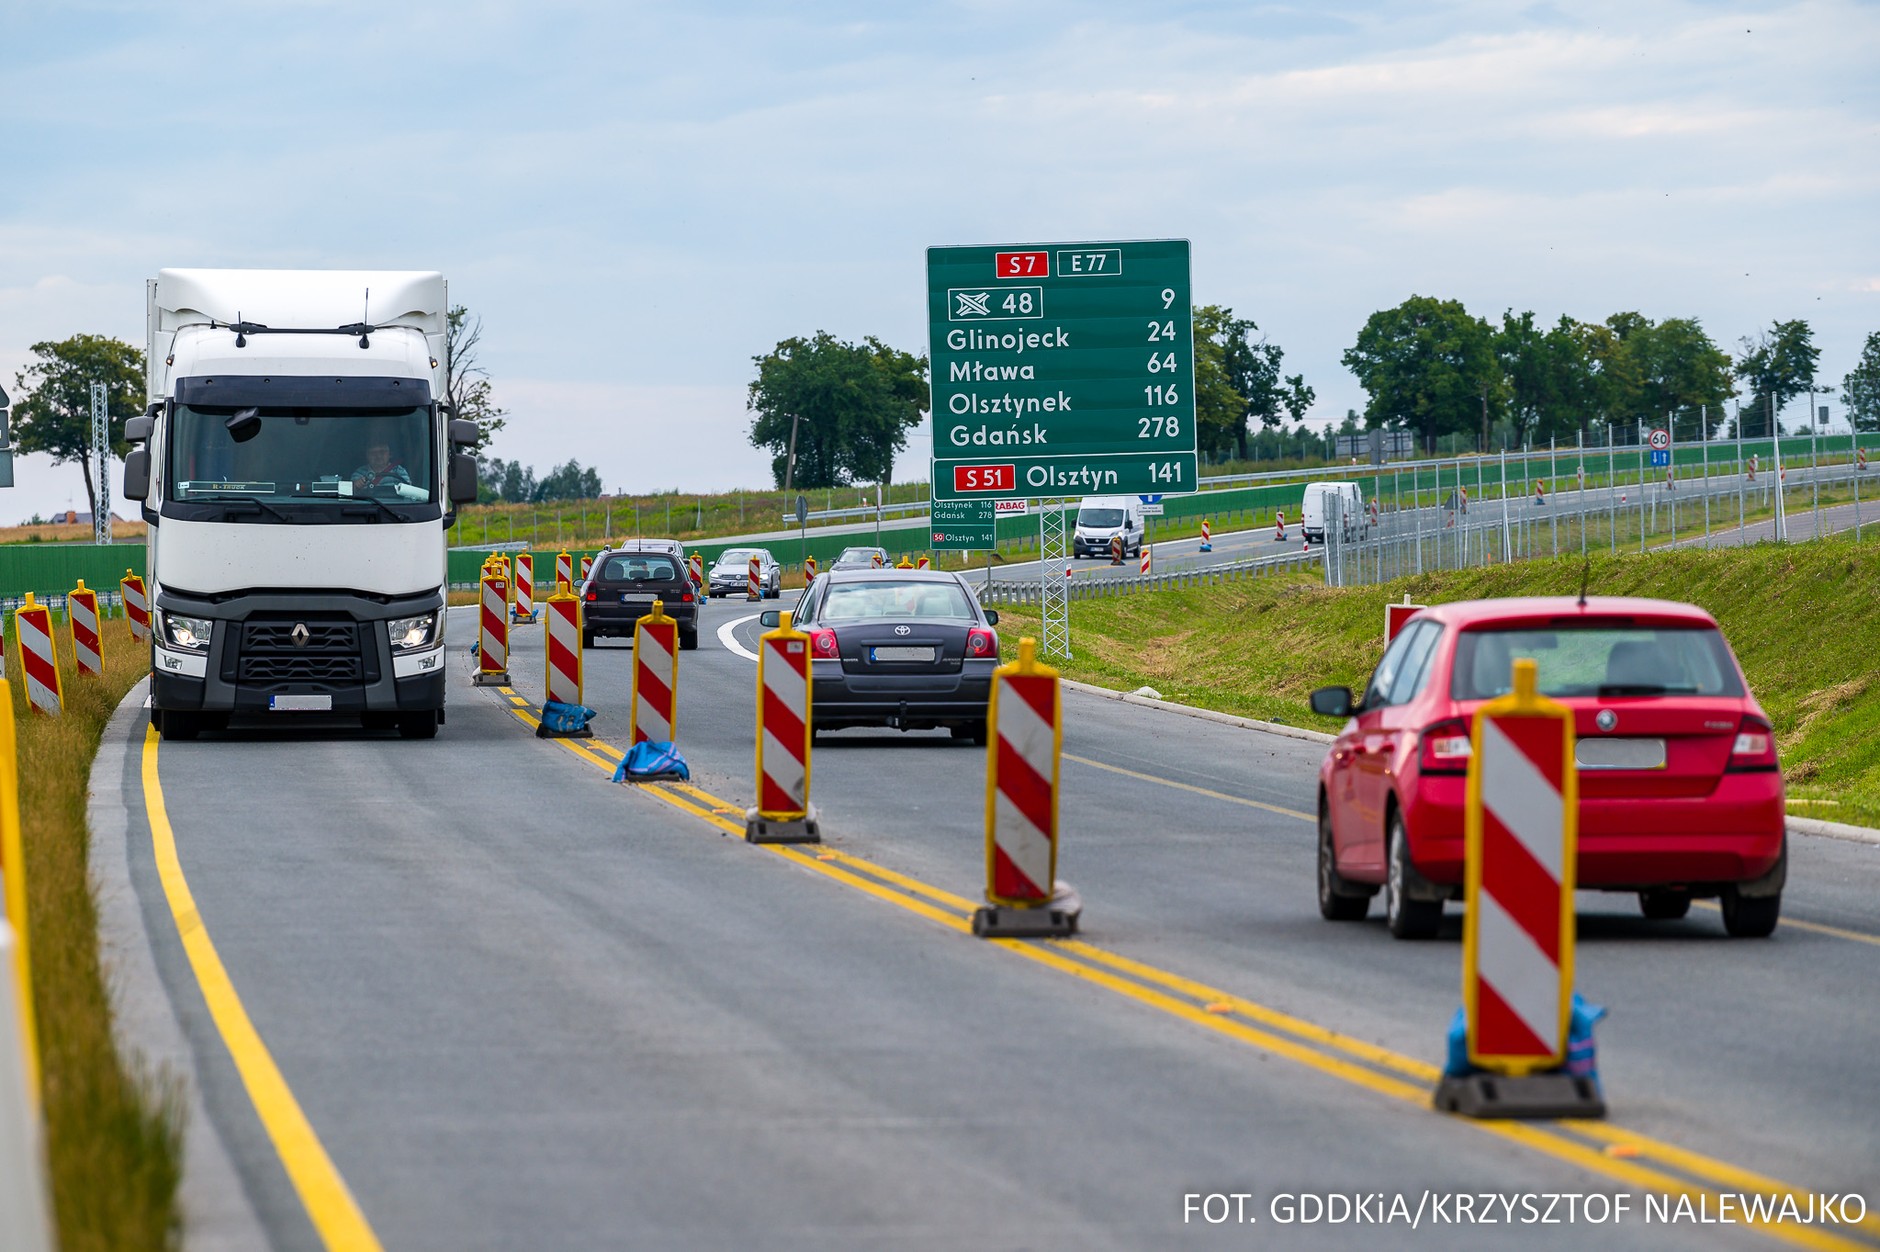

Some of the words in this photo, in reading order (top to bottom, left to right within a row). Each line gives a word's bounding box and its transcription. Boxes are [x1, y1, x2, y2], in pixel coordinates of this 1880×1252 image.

[1002, 292, 1033, 314] 48
[1161, 288, 1176, 310] 9
[947, 326, 1070, 354] Glinojeck
[1147, 320, 1176, 342] 24
[950, 360, 1035, 382] Mława
[1147, 352, 1177, 374] 64
[949, 390, 1072, 419] Olsztynek
[1144, 383, 1179, 406] 116
[950, 424, 1047, 447] Gdańsk
[1138, 416, 1180, 438] 278
[1652, 433, 1667, 444] 60
[1026, 465, 1118, 491] Olsztyn
[1148, 461, 1181, 483] 141
[934, 501, 973, 510] Olsztynek
[980, 501, 992, 509] 116
[934, 511, 965, 519] Gdańsk
[978, 511, 993, 519] 278
[945, 533, 975, 543] Olsztyn
[981, 533, 993, 541] 141
